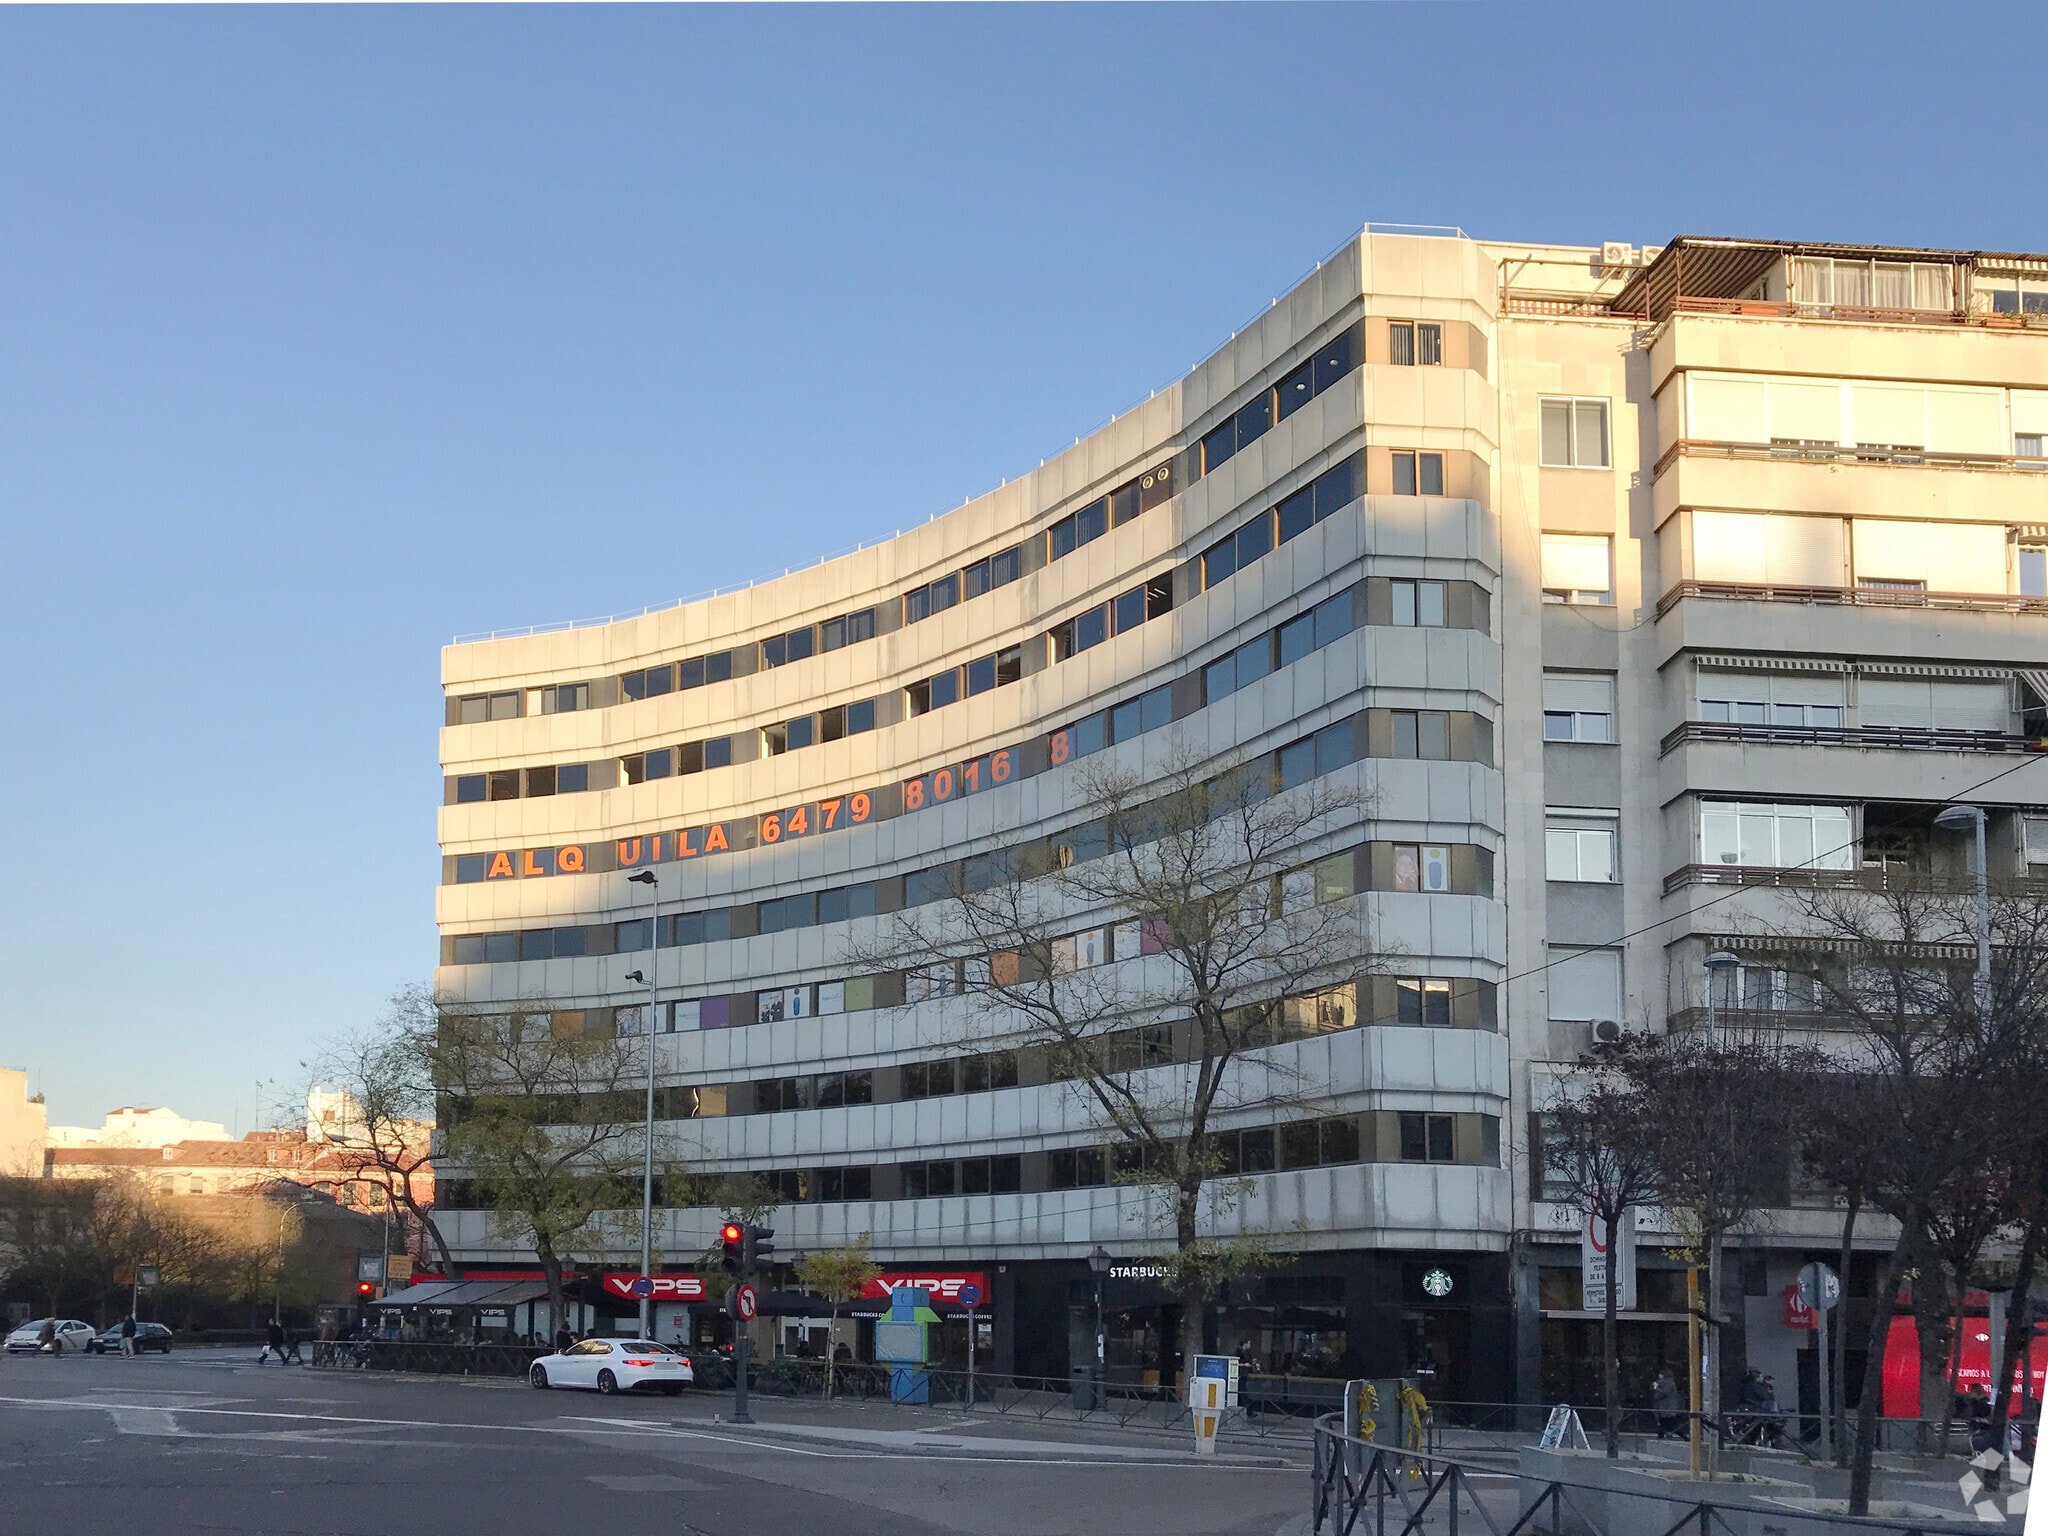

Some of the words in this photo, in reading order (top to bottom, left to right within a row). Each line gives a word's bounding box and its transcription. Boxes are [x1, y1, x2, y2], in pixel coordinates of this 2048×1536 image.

[760, 791, 871, 843] 6479
[903, 751, 1012, 810] 8016
[1050, 730, 1070, 768] 8
[1109, 1266, 1177, 1278] STARBUC
[611, 1279, 702, 1294] VPS
